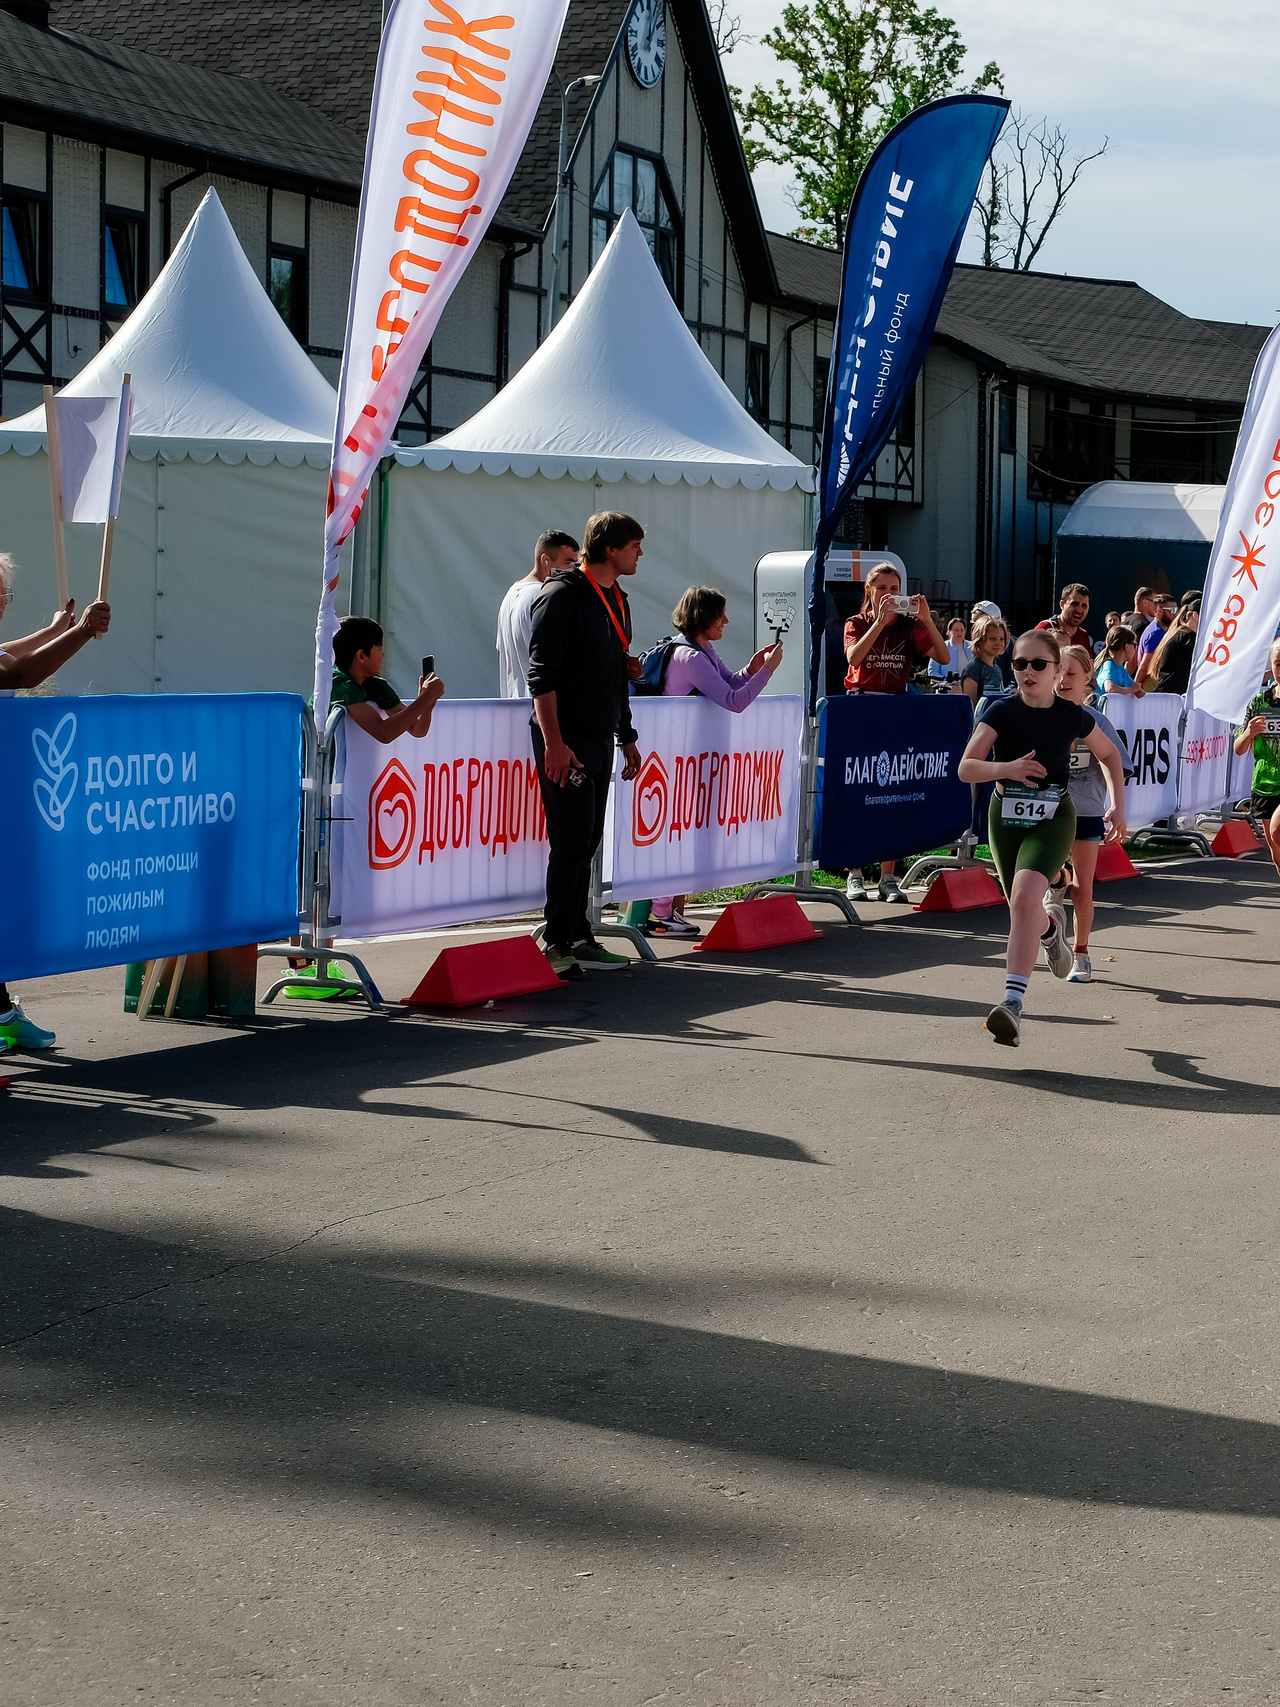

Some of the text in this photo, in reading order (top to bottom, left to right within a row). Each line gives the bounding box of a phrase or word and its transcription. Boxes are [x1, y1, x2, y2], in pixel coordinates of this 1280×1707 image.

[886, 293, 911, 344] фонд
[1205, 594, 1245, 667] 585
[873, 661, 904, 669] ОЛОТЫМ
[85, 751, 198, 796] ДОЛГО И
[844, 747, 950, 787] БЛАГОДЕЙСТВИЕ
[1115, 727, 1171, 787] ARS
[86, 791, 236, 835] СЧАСТЛИВО
[418, 757, 549, 866] ДОБРОДОМ
[668, 748, 785, 845] ДОБРОДОМИК
[1014, 801, 1046, 818] 614
[86, 851, 199, 882] ФОНД ПОМОЩИ
[86, 888, 165, 916] ПОЖИЛЫМ
[84, 924, 140, 951] ЛЮДЯМ
